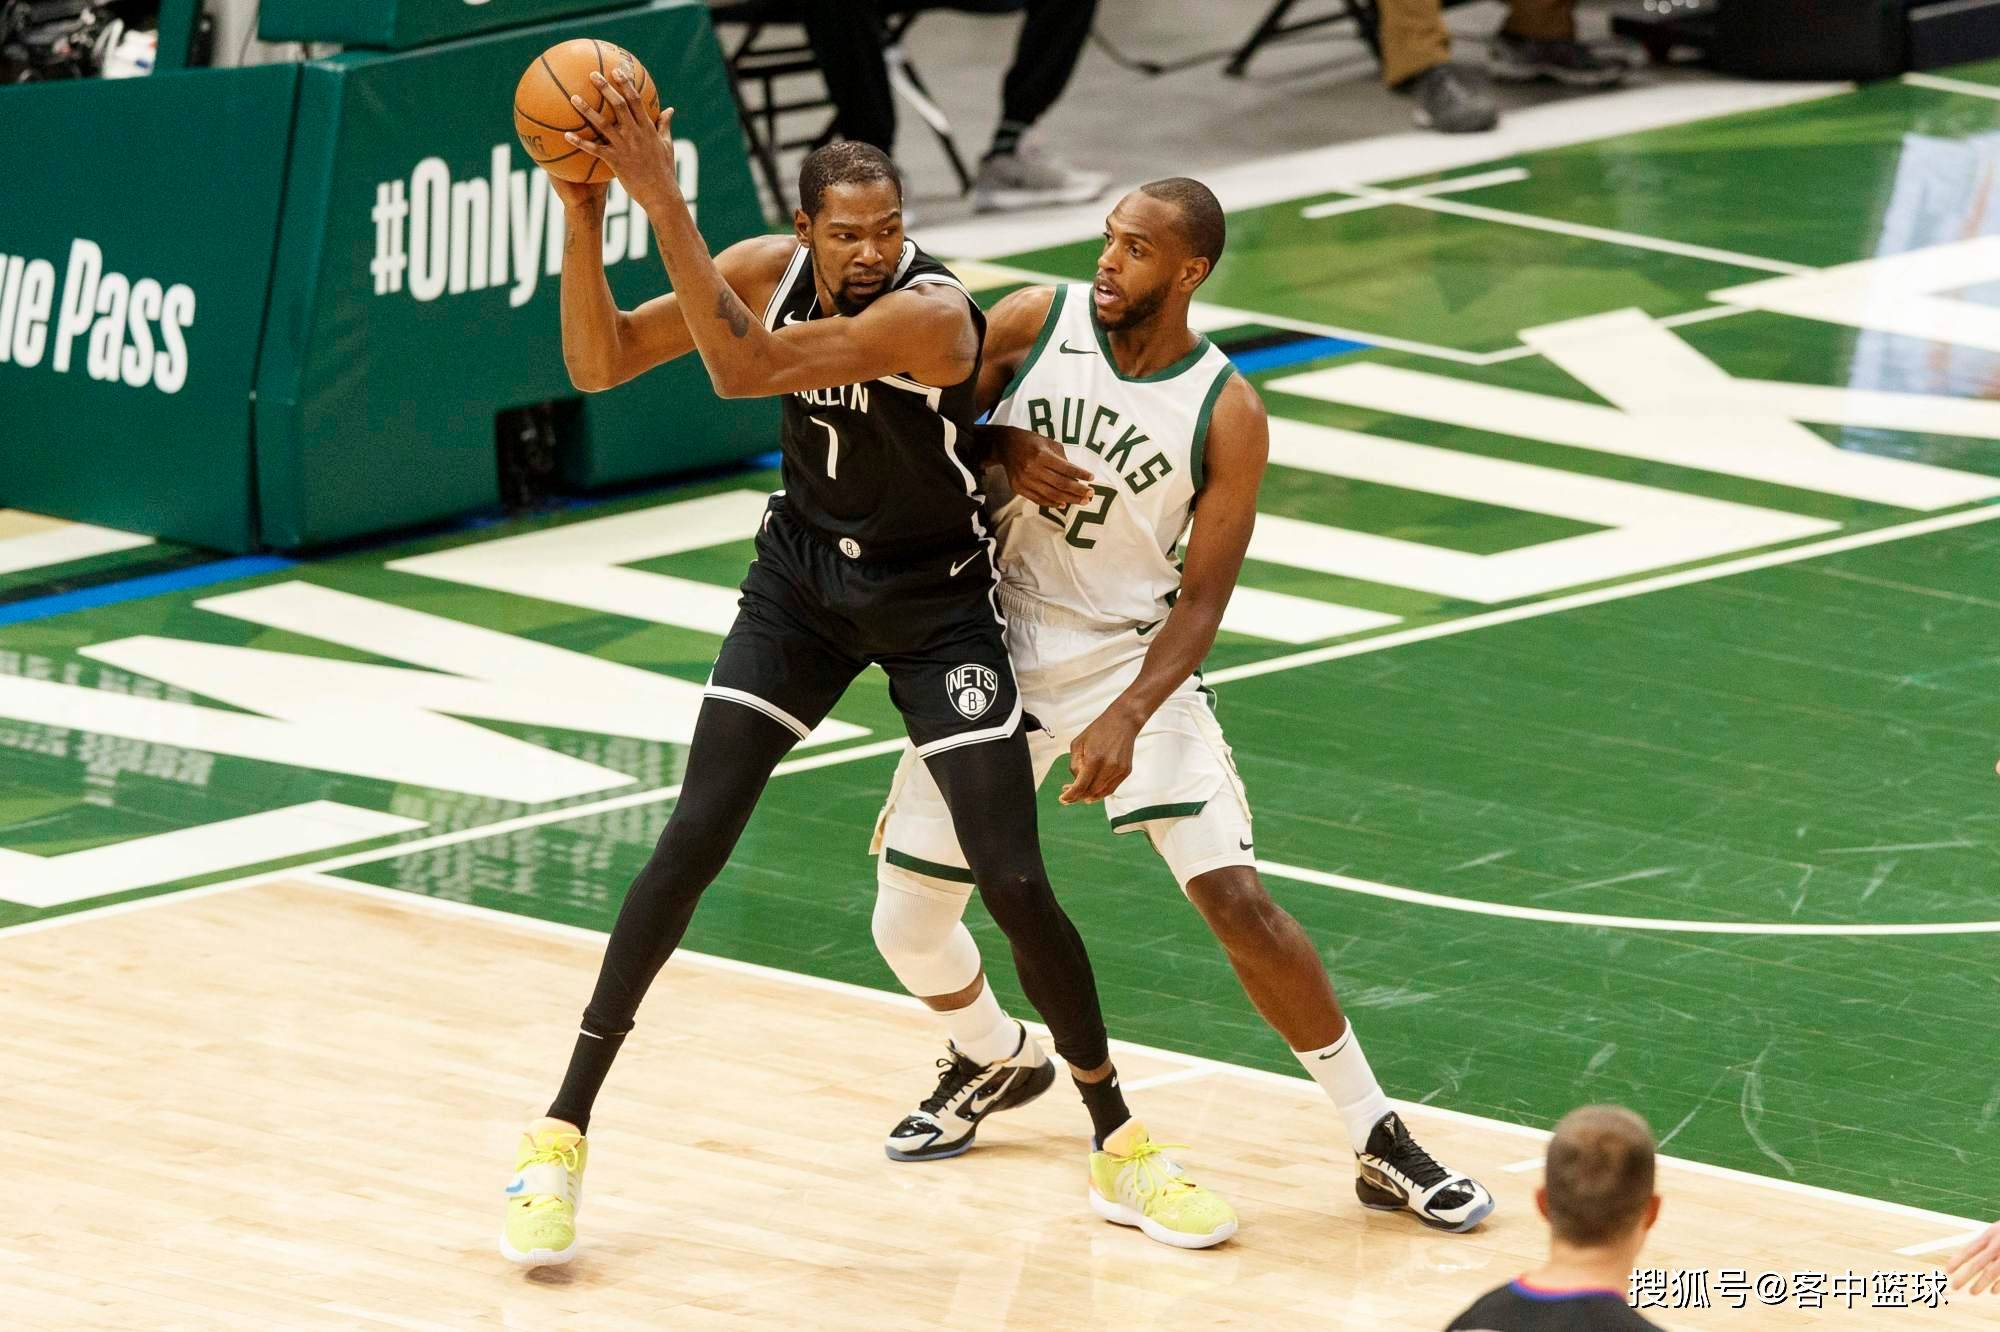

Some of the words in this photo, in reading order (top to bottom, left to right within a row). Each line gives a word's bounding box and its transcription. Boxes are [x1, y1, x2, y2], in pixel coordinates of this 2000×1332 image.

[53, 237, 196, 394] Pass
[809, 415, 839, 480] 7
[1028, 397, 1173, 495] BUCKS
[949, 666, 996, 694] NETS
[968, 691, 978, 711] B
